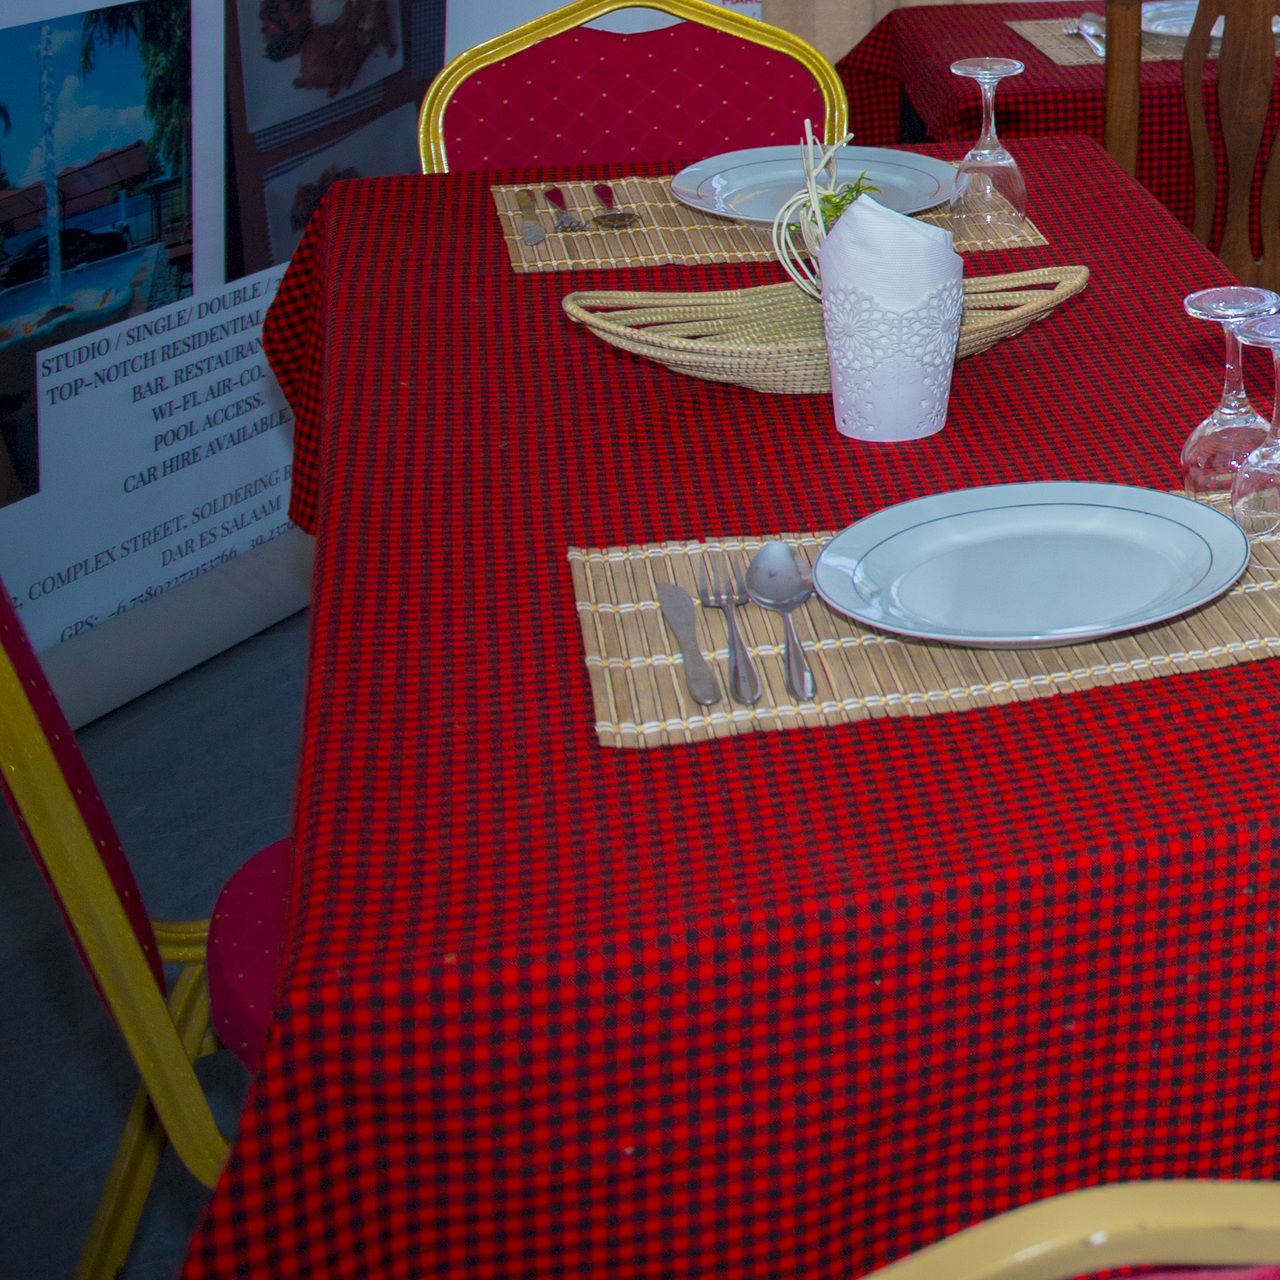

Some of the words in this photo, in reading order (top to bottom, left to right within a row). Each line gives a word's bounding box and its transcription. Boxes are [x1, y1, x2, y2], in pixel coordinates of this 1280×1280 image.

[41, 337, 110, 378] STUDIO
[198, 281, 261, 320] DOUBLE
[46, 349, 157, 406] TOP-NOTCH
[161, 310, 264, 362] RESIDENTIAL
[153, 419, 198, 452] POOL
[202, 392, 265, 430] ACCESS.
[124, 467, 157, 493] CAR
[162, 445, 202, 476] HIRE
[28, 546, 118, 600] COMPLEX
[192, 470, 279, 524] SOLDERING
[162, 539, 195, 567] DAR
[200, 527, 217, 548] ES
[221, 495, 281, 535] SALAAM
